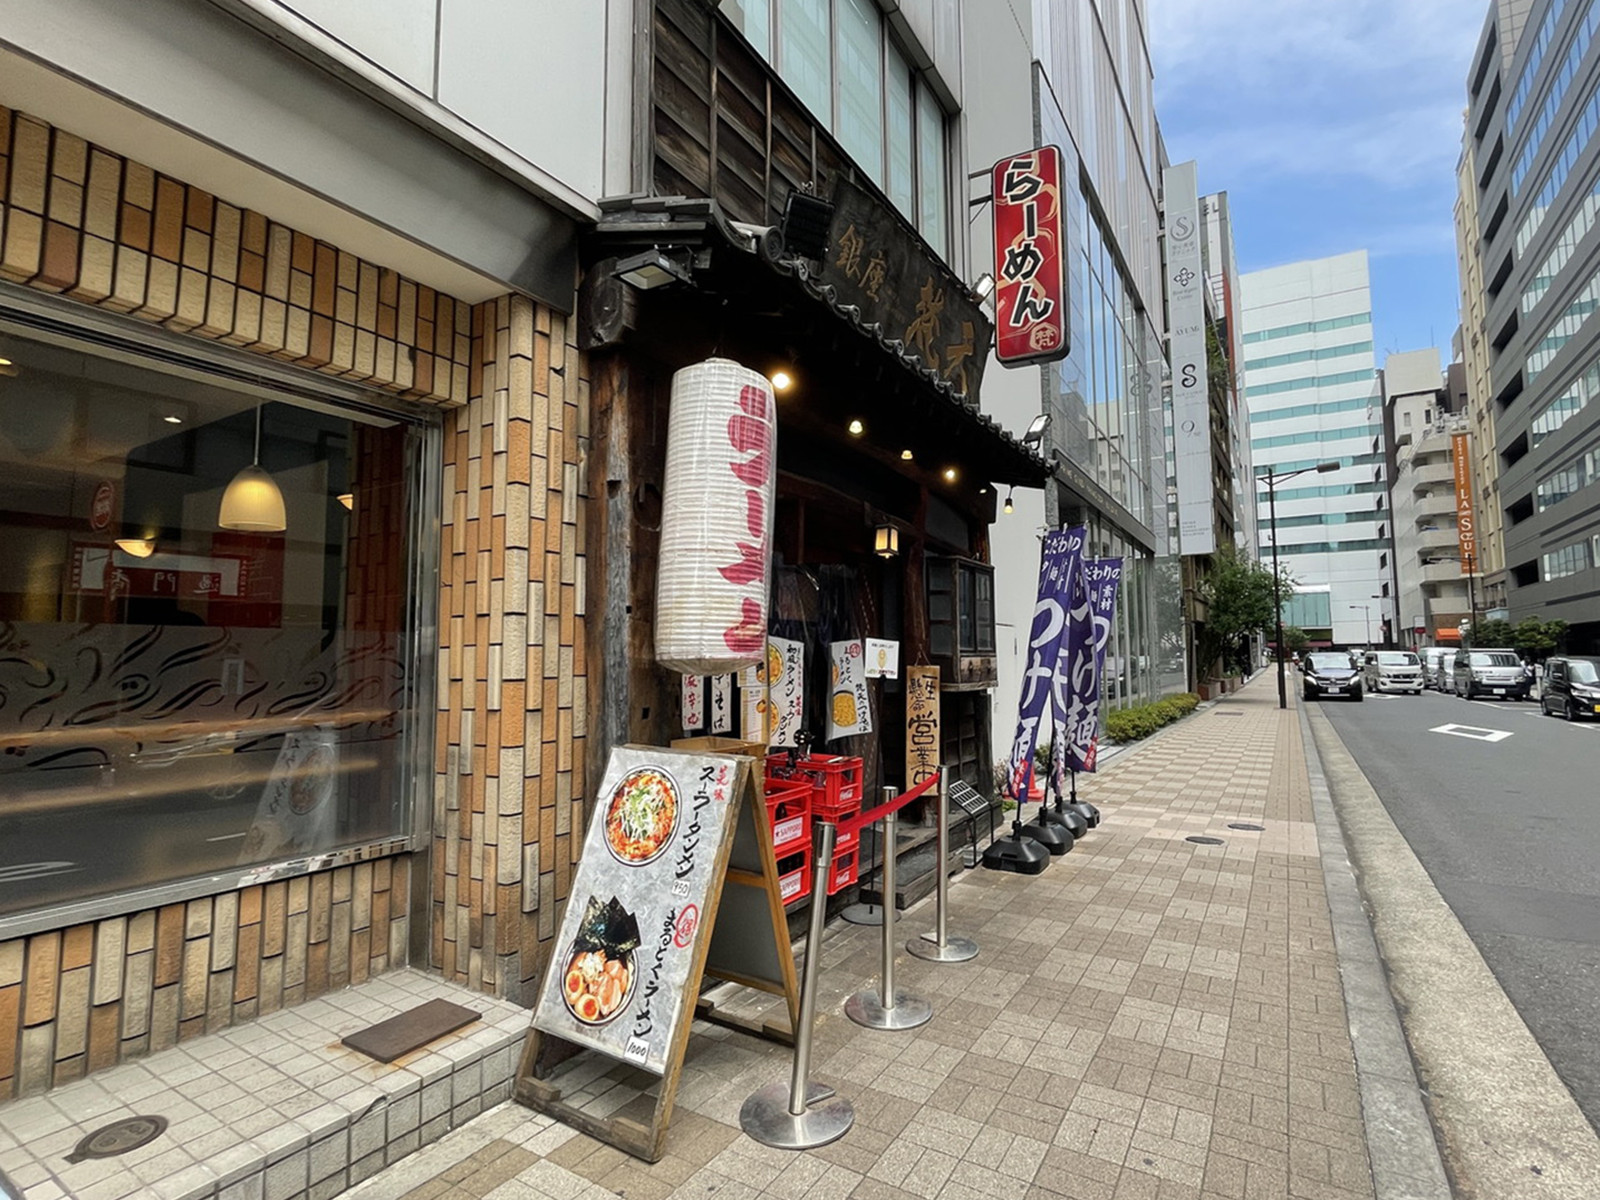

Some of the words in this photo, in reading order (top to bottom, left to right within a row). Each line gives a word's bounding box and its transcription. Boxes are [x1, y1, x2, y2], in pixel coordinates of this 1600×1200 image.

[836, 224, 888, 302] 銀座
[1001, 158, 1055, 327] らーめん
[1181, 363, 1197, 389] S
[922, 674, 938, 700] 一生
[908, 710, 938, 786] 営業中
[675, 766, 715, 879] スーラータンメン
[627, 1042, 647, 1058] 1000
